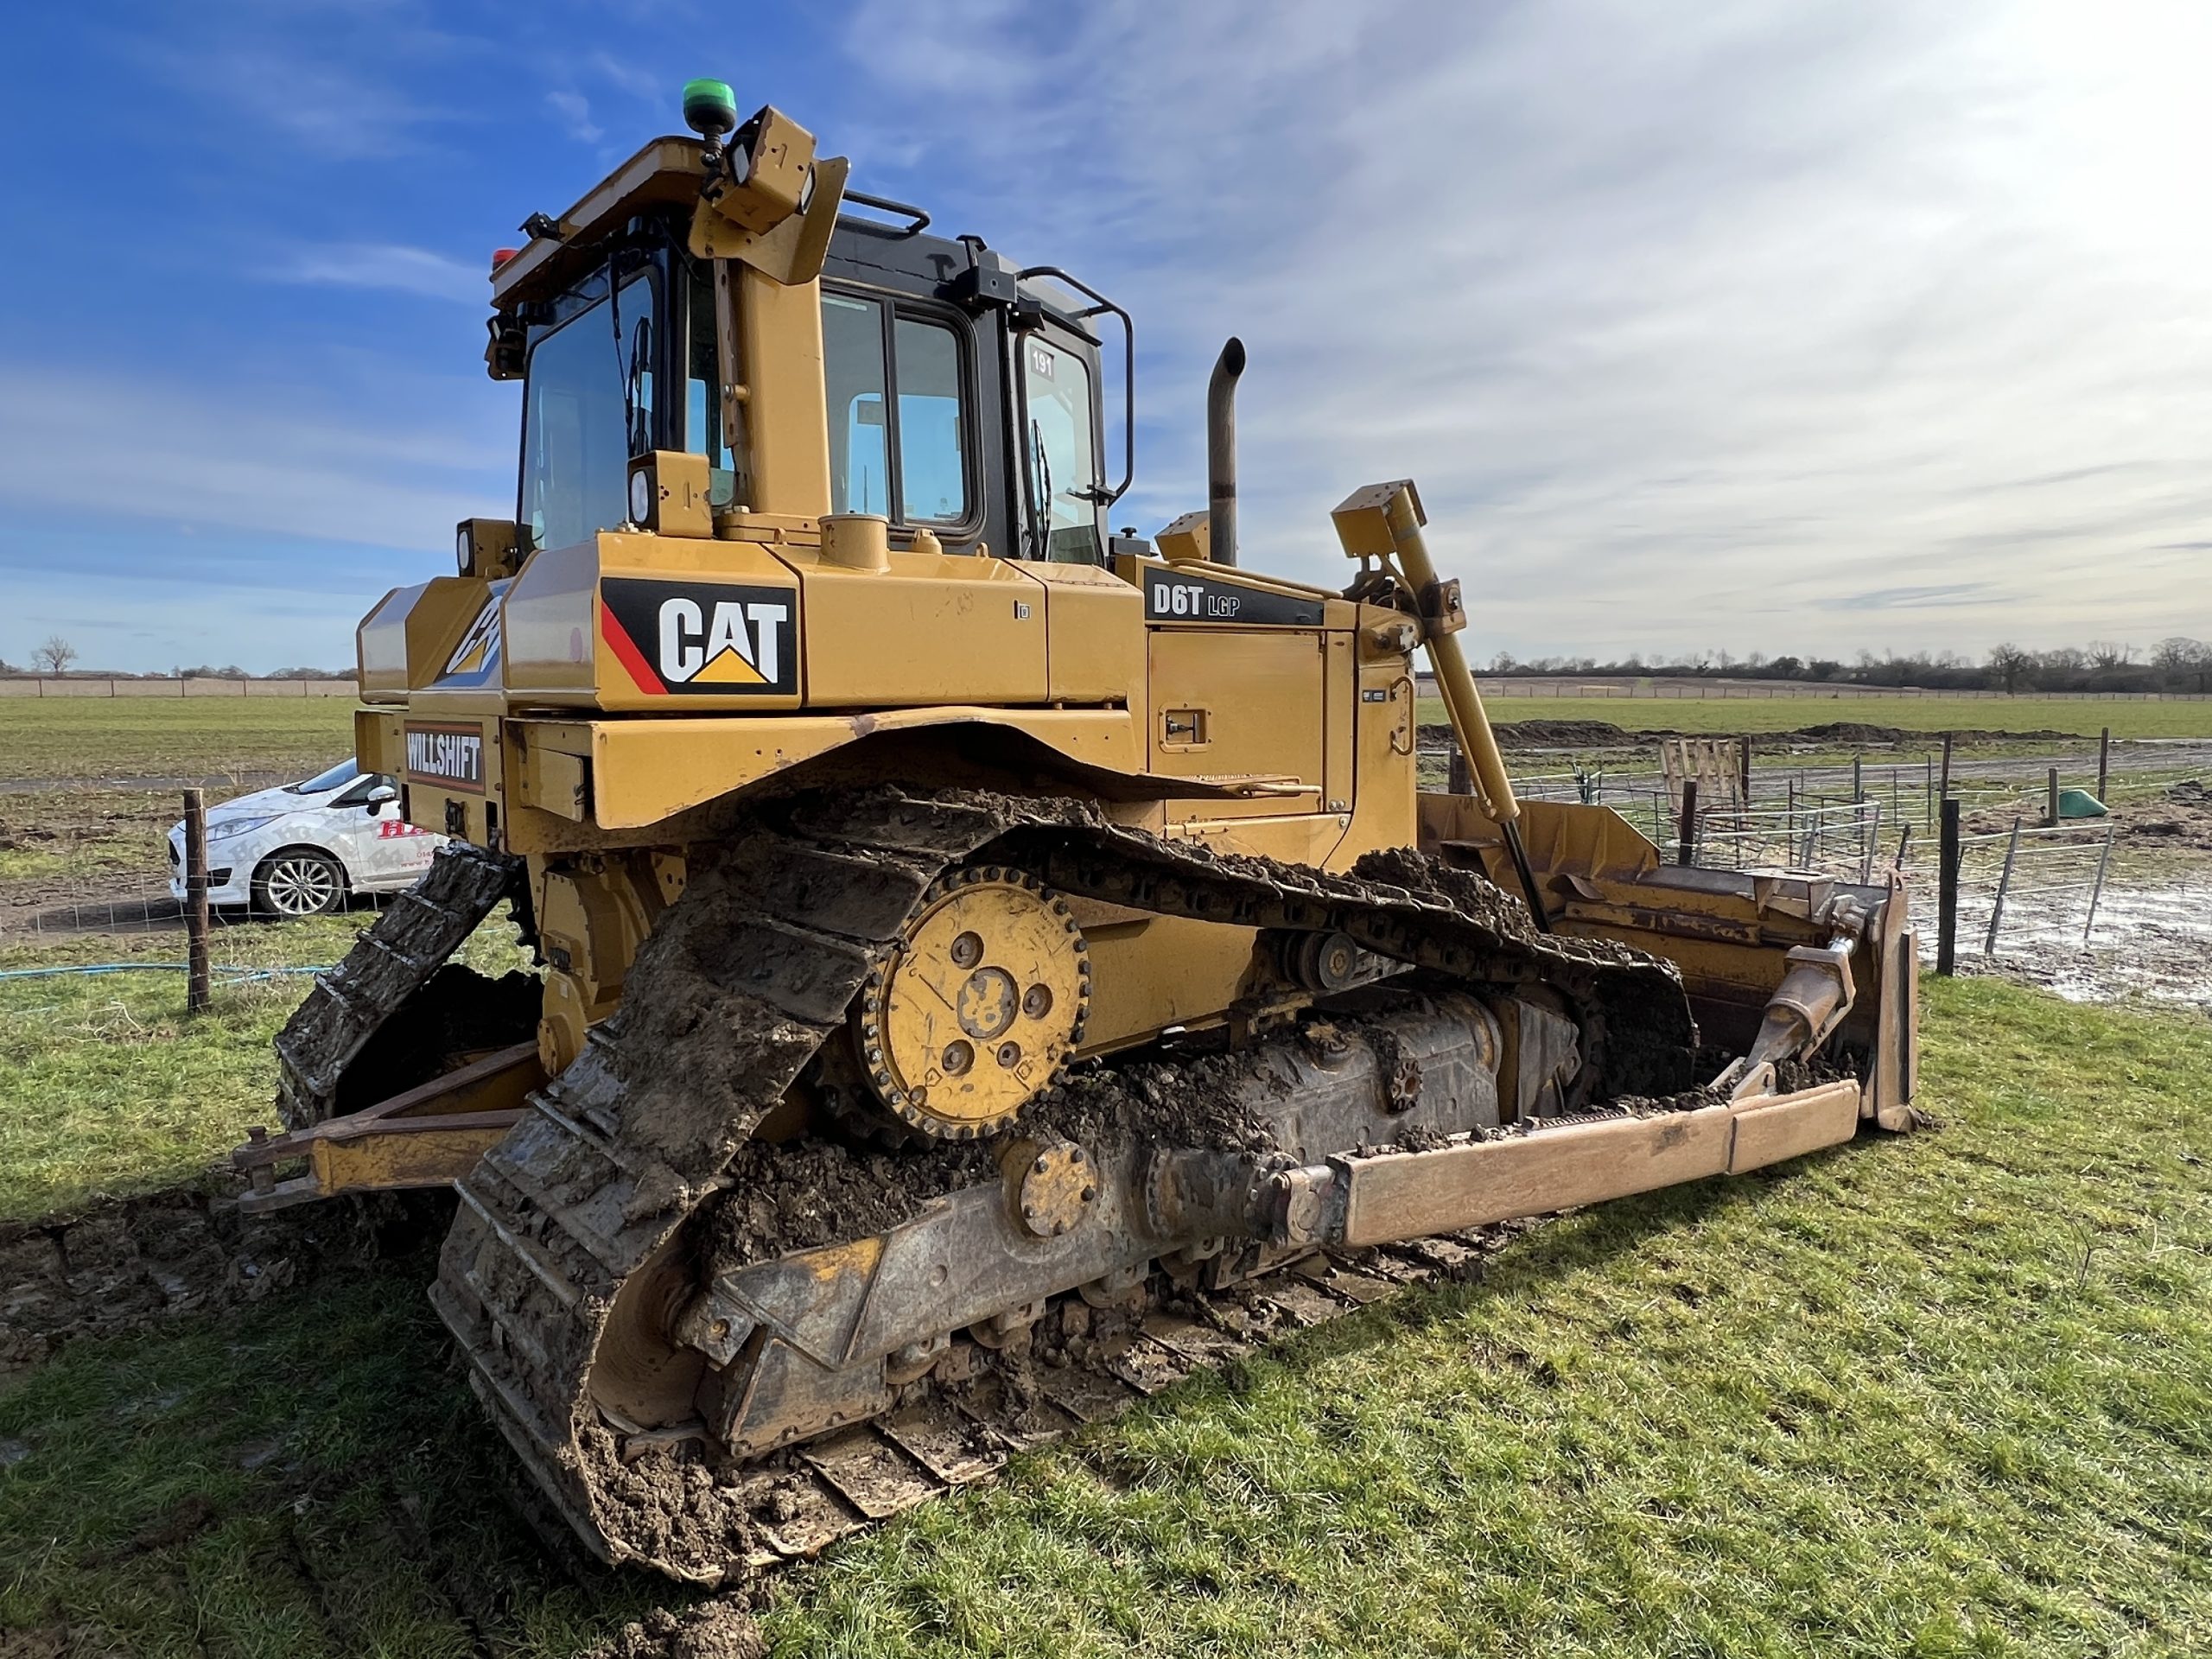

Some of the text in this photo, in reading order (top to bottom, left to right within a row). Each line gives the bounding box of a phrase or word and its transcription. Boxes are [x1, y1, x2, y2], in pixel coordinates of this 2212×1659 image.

[1033, 350, 1052, 377] 191
[1154, 583, 1240, 617] D6T LGP
[659, 598, 787, 683] CAT
[407, 733, 480, 780] WILLSHIFT
